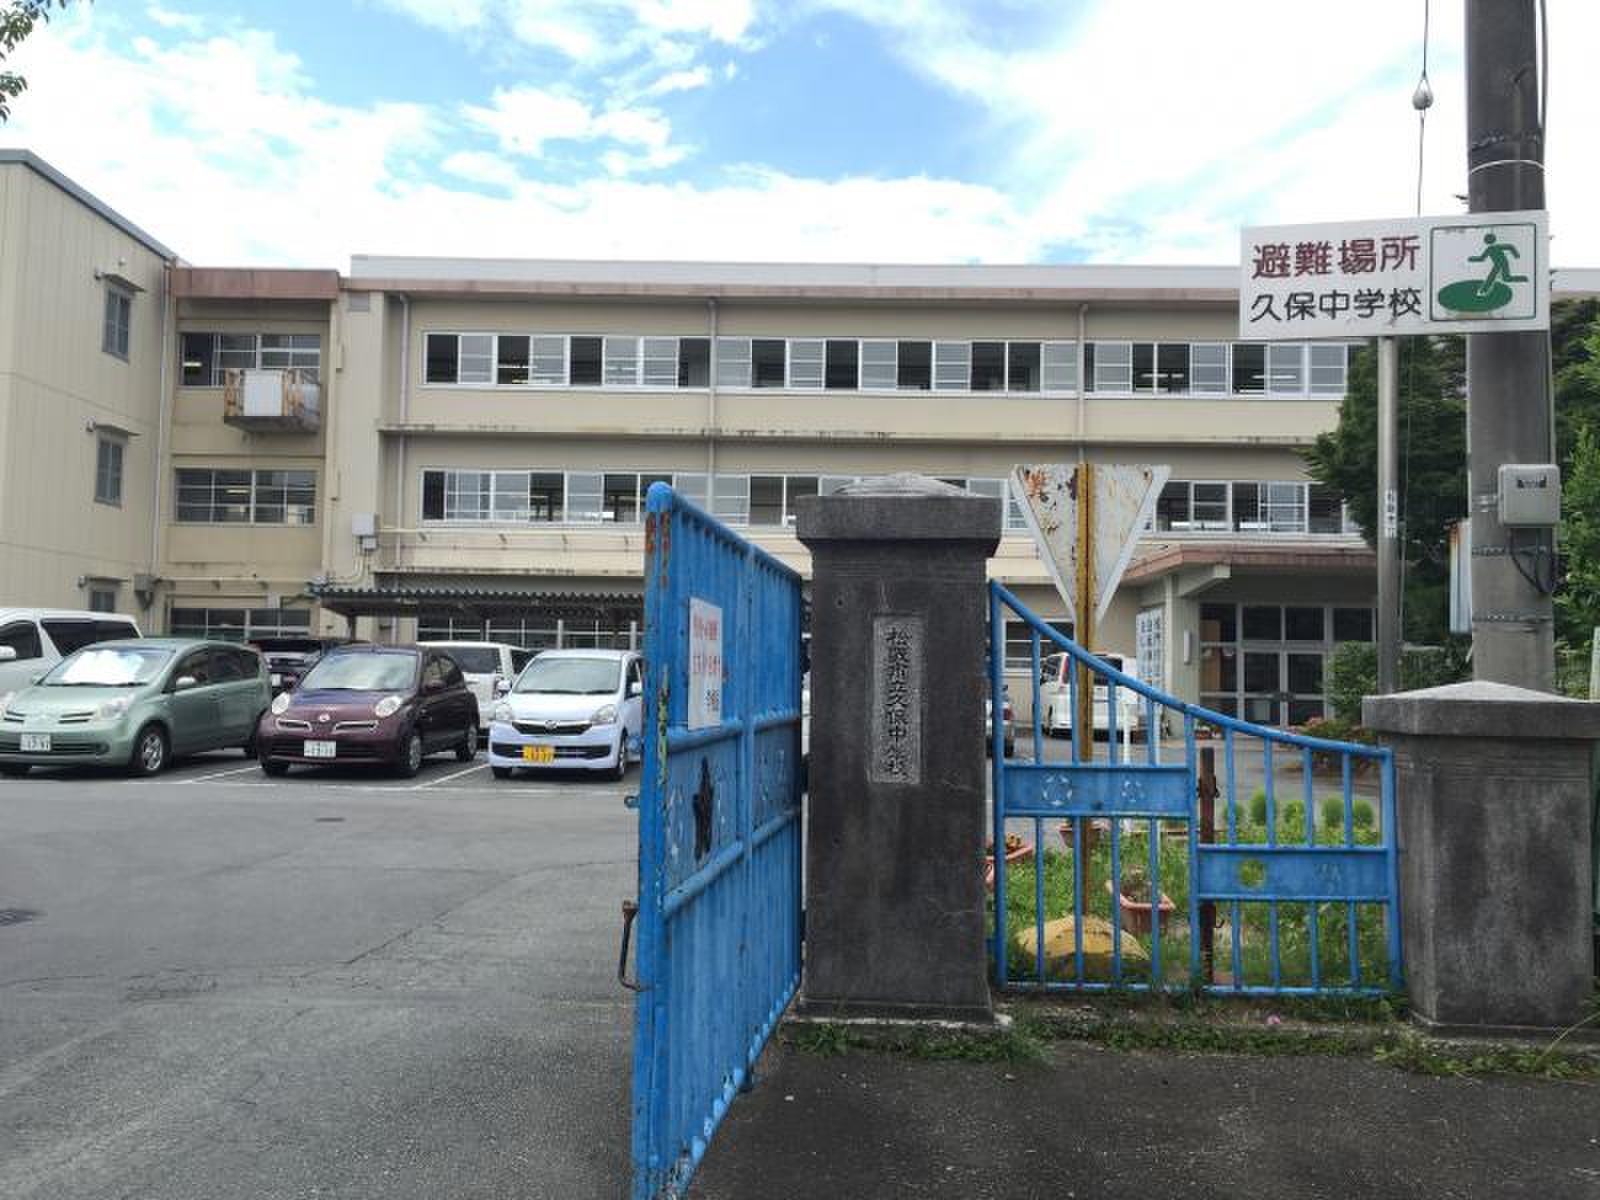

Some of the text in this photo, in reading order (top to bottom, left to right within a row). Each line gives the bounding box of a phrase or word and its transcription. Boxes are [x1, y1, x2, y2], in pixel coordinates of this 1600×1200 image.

[1252, 235, 1421, 280] 避難場所
[1250, 288, 1422, 322] 久保中学校
